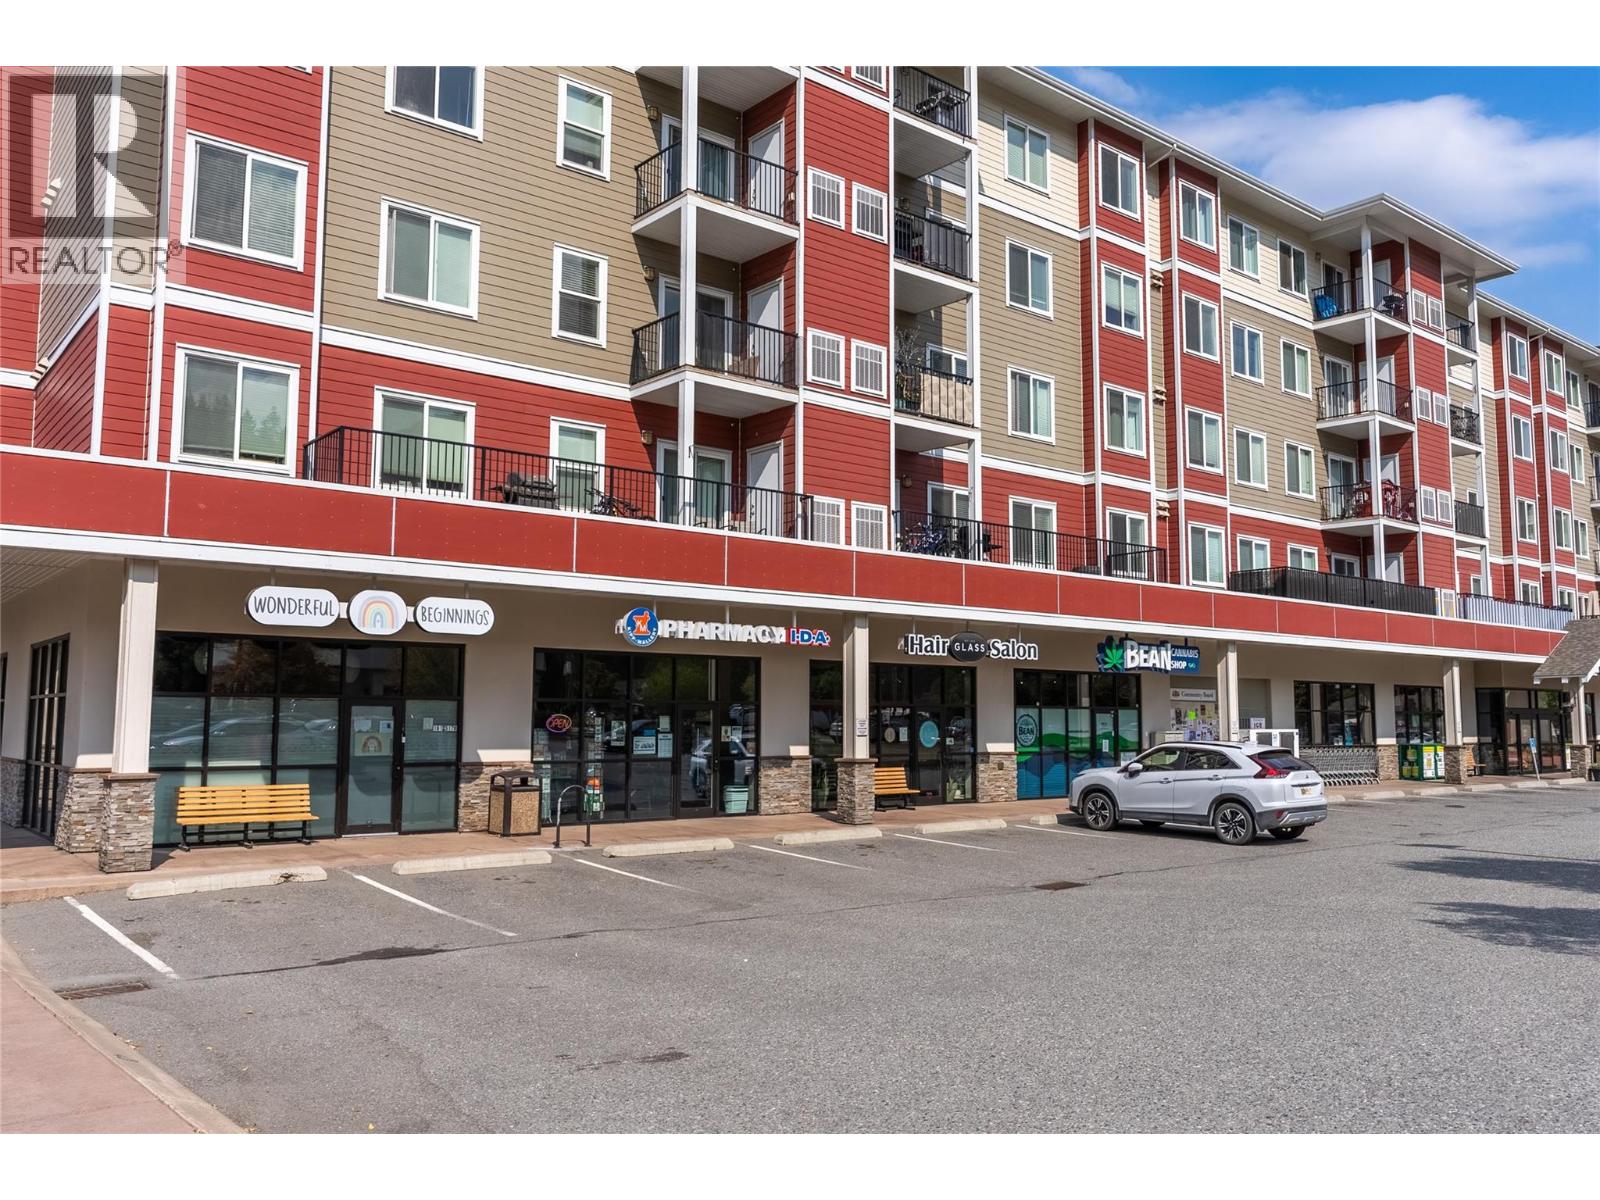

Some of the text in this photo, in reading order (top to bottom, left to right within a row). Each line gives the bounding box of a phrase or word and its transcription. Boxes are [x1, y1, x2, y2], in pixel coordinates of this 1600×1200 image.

[253, 595, 490, 626] WONDERFUL BEGINNINGS
[660, 619, 787, 644] PHARMACY
[907, 634, 1039, 661] Hair GLASS Salon
[1125, 640, 1172, 671] BEAN
[1171, 647, 1199, 658] CANNABIS
[1170, 660, 1187, 670] SHOP
